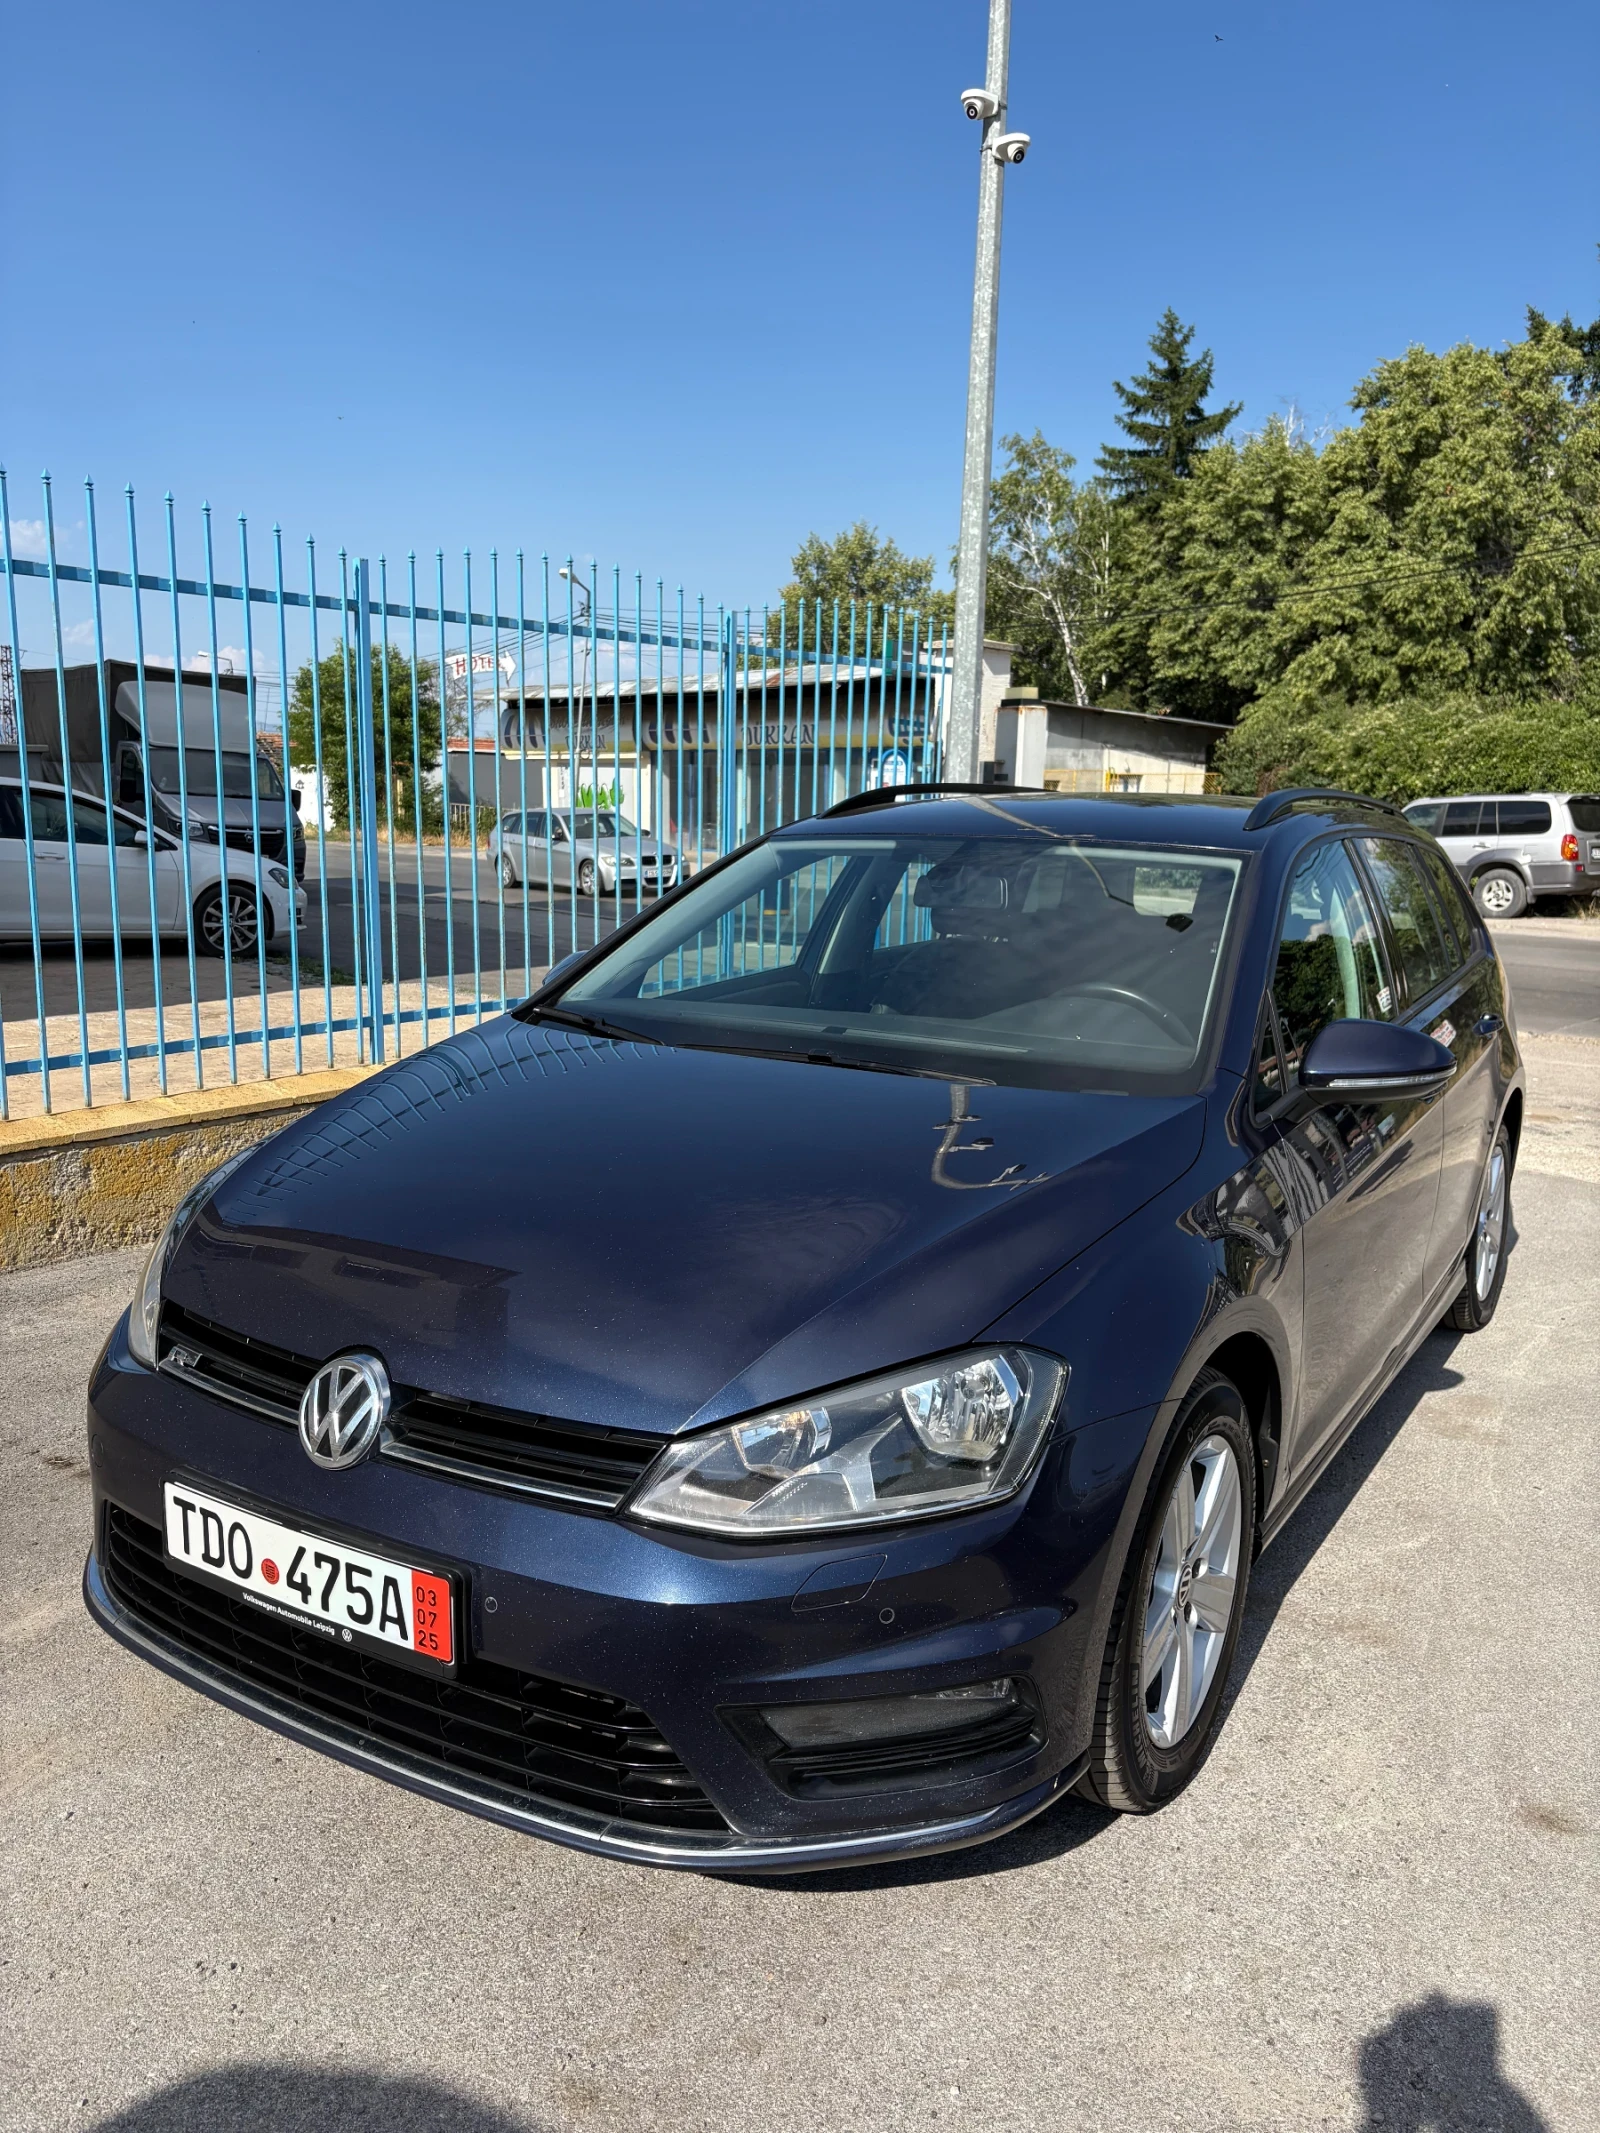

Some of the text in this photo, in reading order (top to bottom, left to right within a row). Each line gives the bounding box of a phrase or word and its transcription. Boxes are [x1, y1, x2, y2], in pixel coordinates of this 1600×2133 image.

[455, 656, 505, 676] HOTE
[173, 1496, 409, 1641] TDO 475A
[416, 1586, 437, 1607] 03
[242, 1592, 335, 1636] Volkswagen Automobile Leipzig
[417, 1608, 437, 1628] 07
[418, 1629, 438, 1650] 25
[1130, 1668, 1147, 1769] MICHELIN
